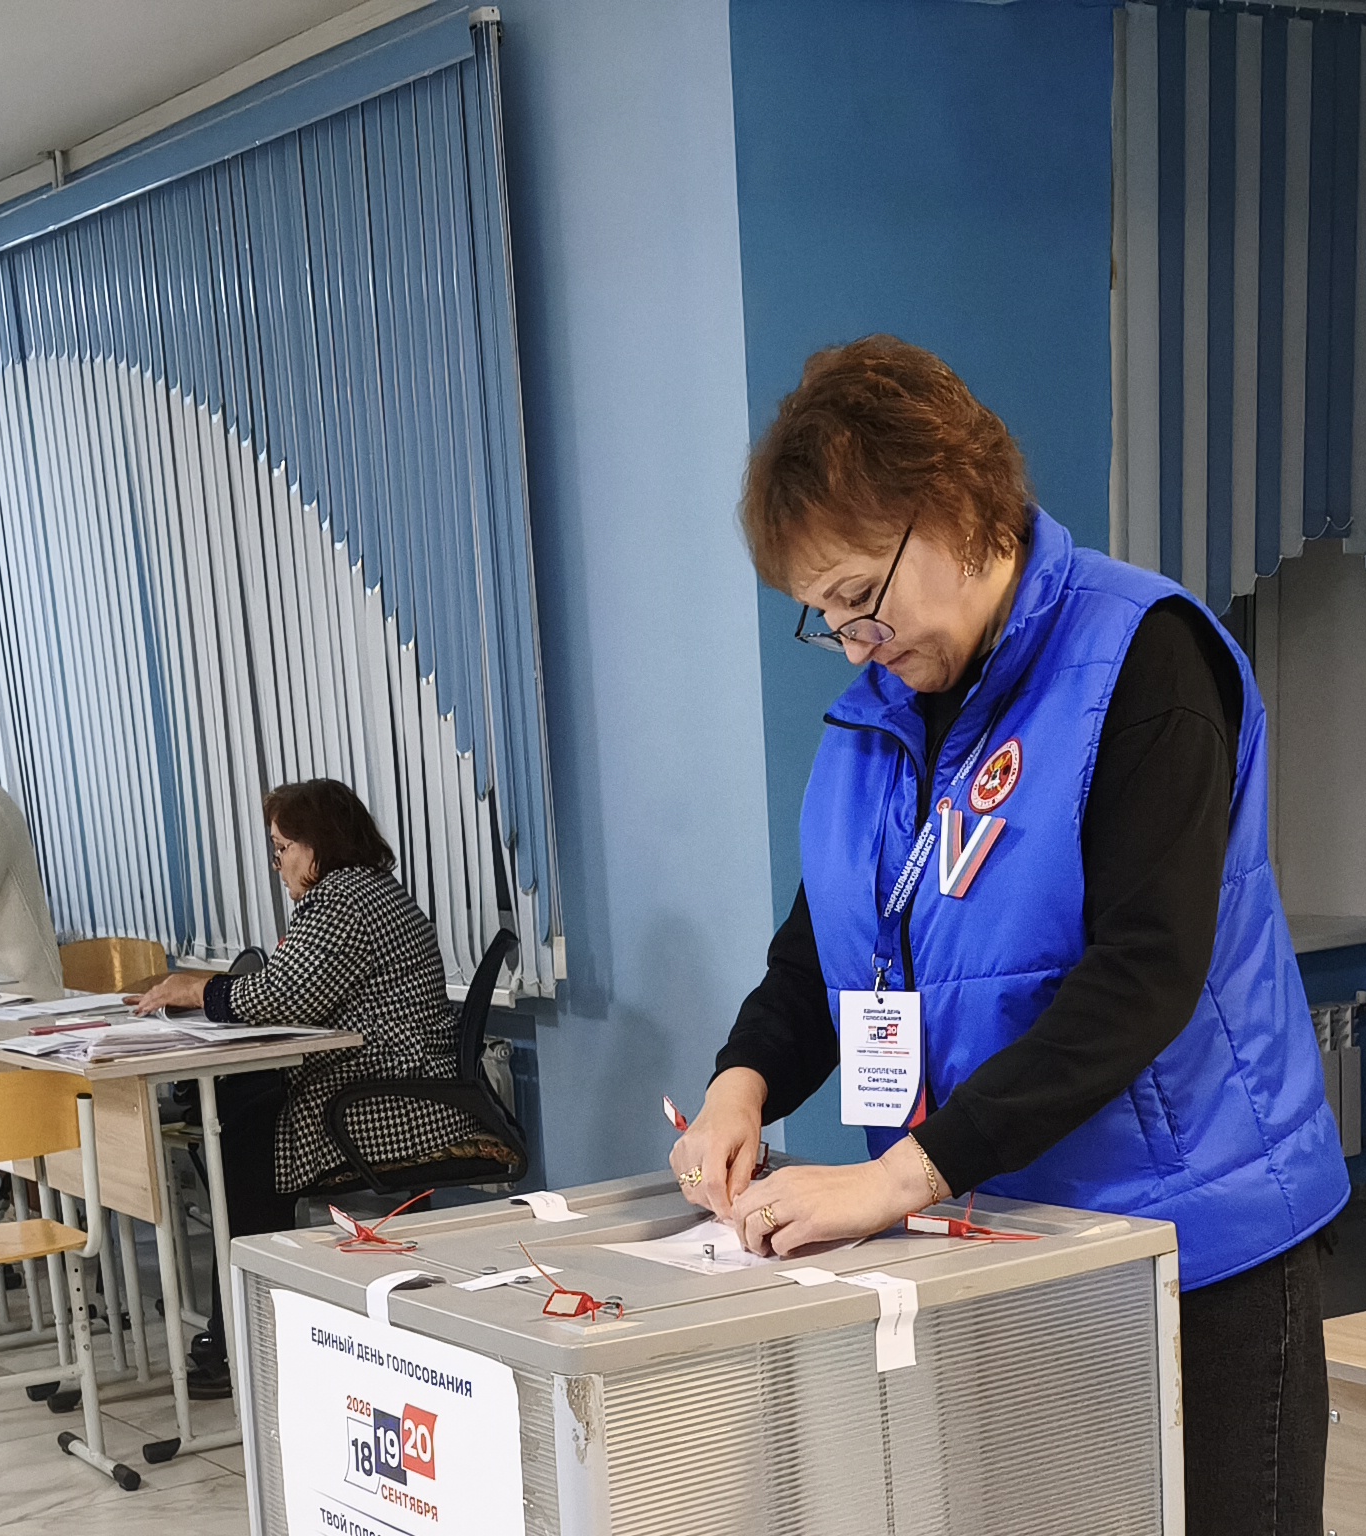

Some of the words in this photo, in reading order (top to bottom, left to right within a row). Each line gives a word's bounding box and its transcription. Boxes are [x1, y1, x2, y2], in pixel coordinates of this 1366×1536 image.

[908, 821, 933, 862] КОМИССИЯ
[894, 866, 922, 913] МОСКОВСКОЙ
[916, 833, 936, 867] ОБЛАСТИ
[310, 1326, 355, 1357] ЕДИНЫЙ
[356, 1344, 385, 1367] ДЕНЬ
[386, 1353, 473, 1399] ГОЛОСОВАНИЯ
[345, 1394, 372, 1418] 2026
[350, 1437, 374, 1477] 18
[376, 1425, 400, 1468] 19
[403, 1418, 433, 1464] 20
[319, 1507, 348, 1535] ТВОЙ
[380, 1484, 439, 1523] СЕНТЯБРЯ
